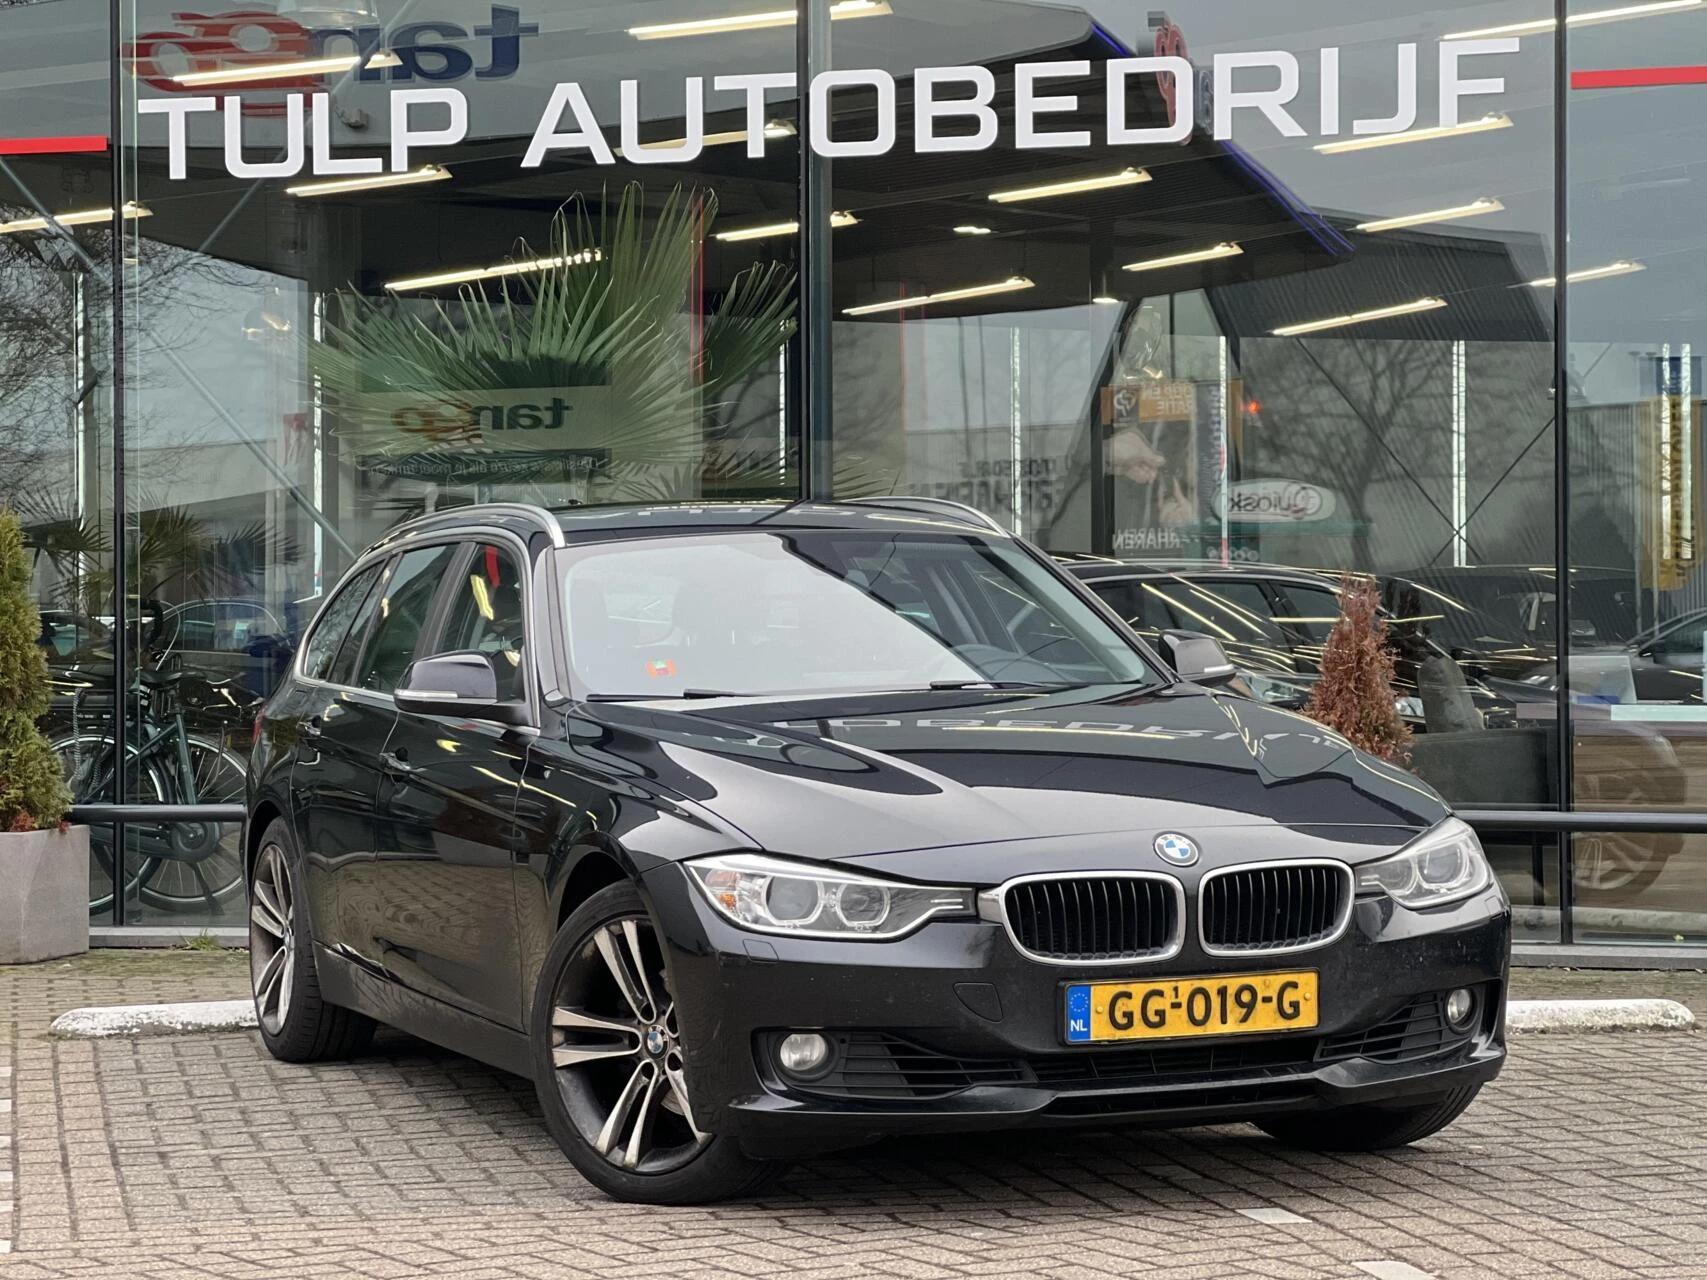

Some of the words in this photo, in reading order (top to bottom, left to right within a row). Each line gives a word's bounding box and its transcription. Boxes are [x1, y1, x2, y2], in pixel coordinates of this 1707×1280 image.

[138, 87, 469, 180] TULP
[521, 37, 1520, 168] AUTOBEDRIJF
[1070, 1019, 1088, 1032] NL
